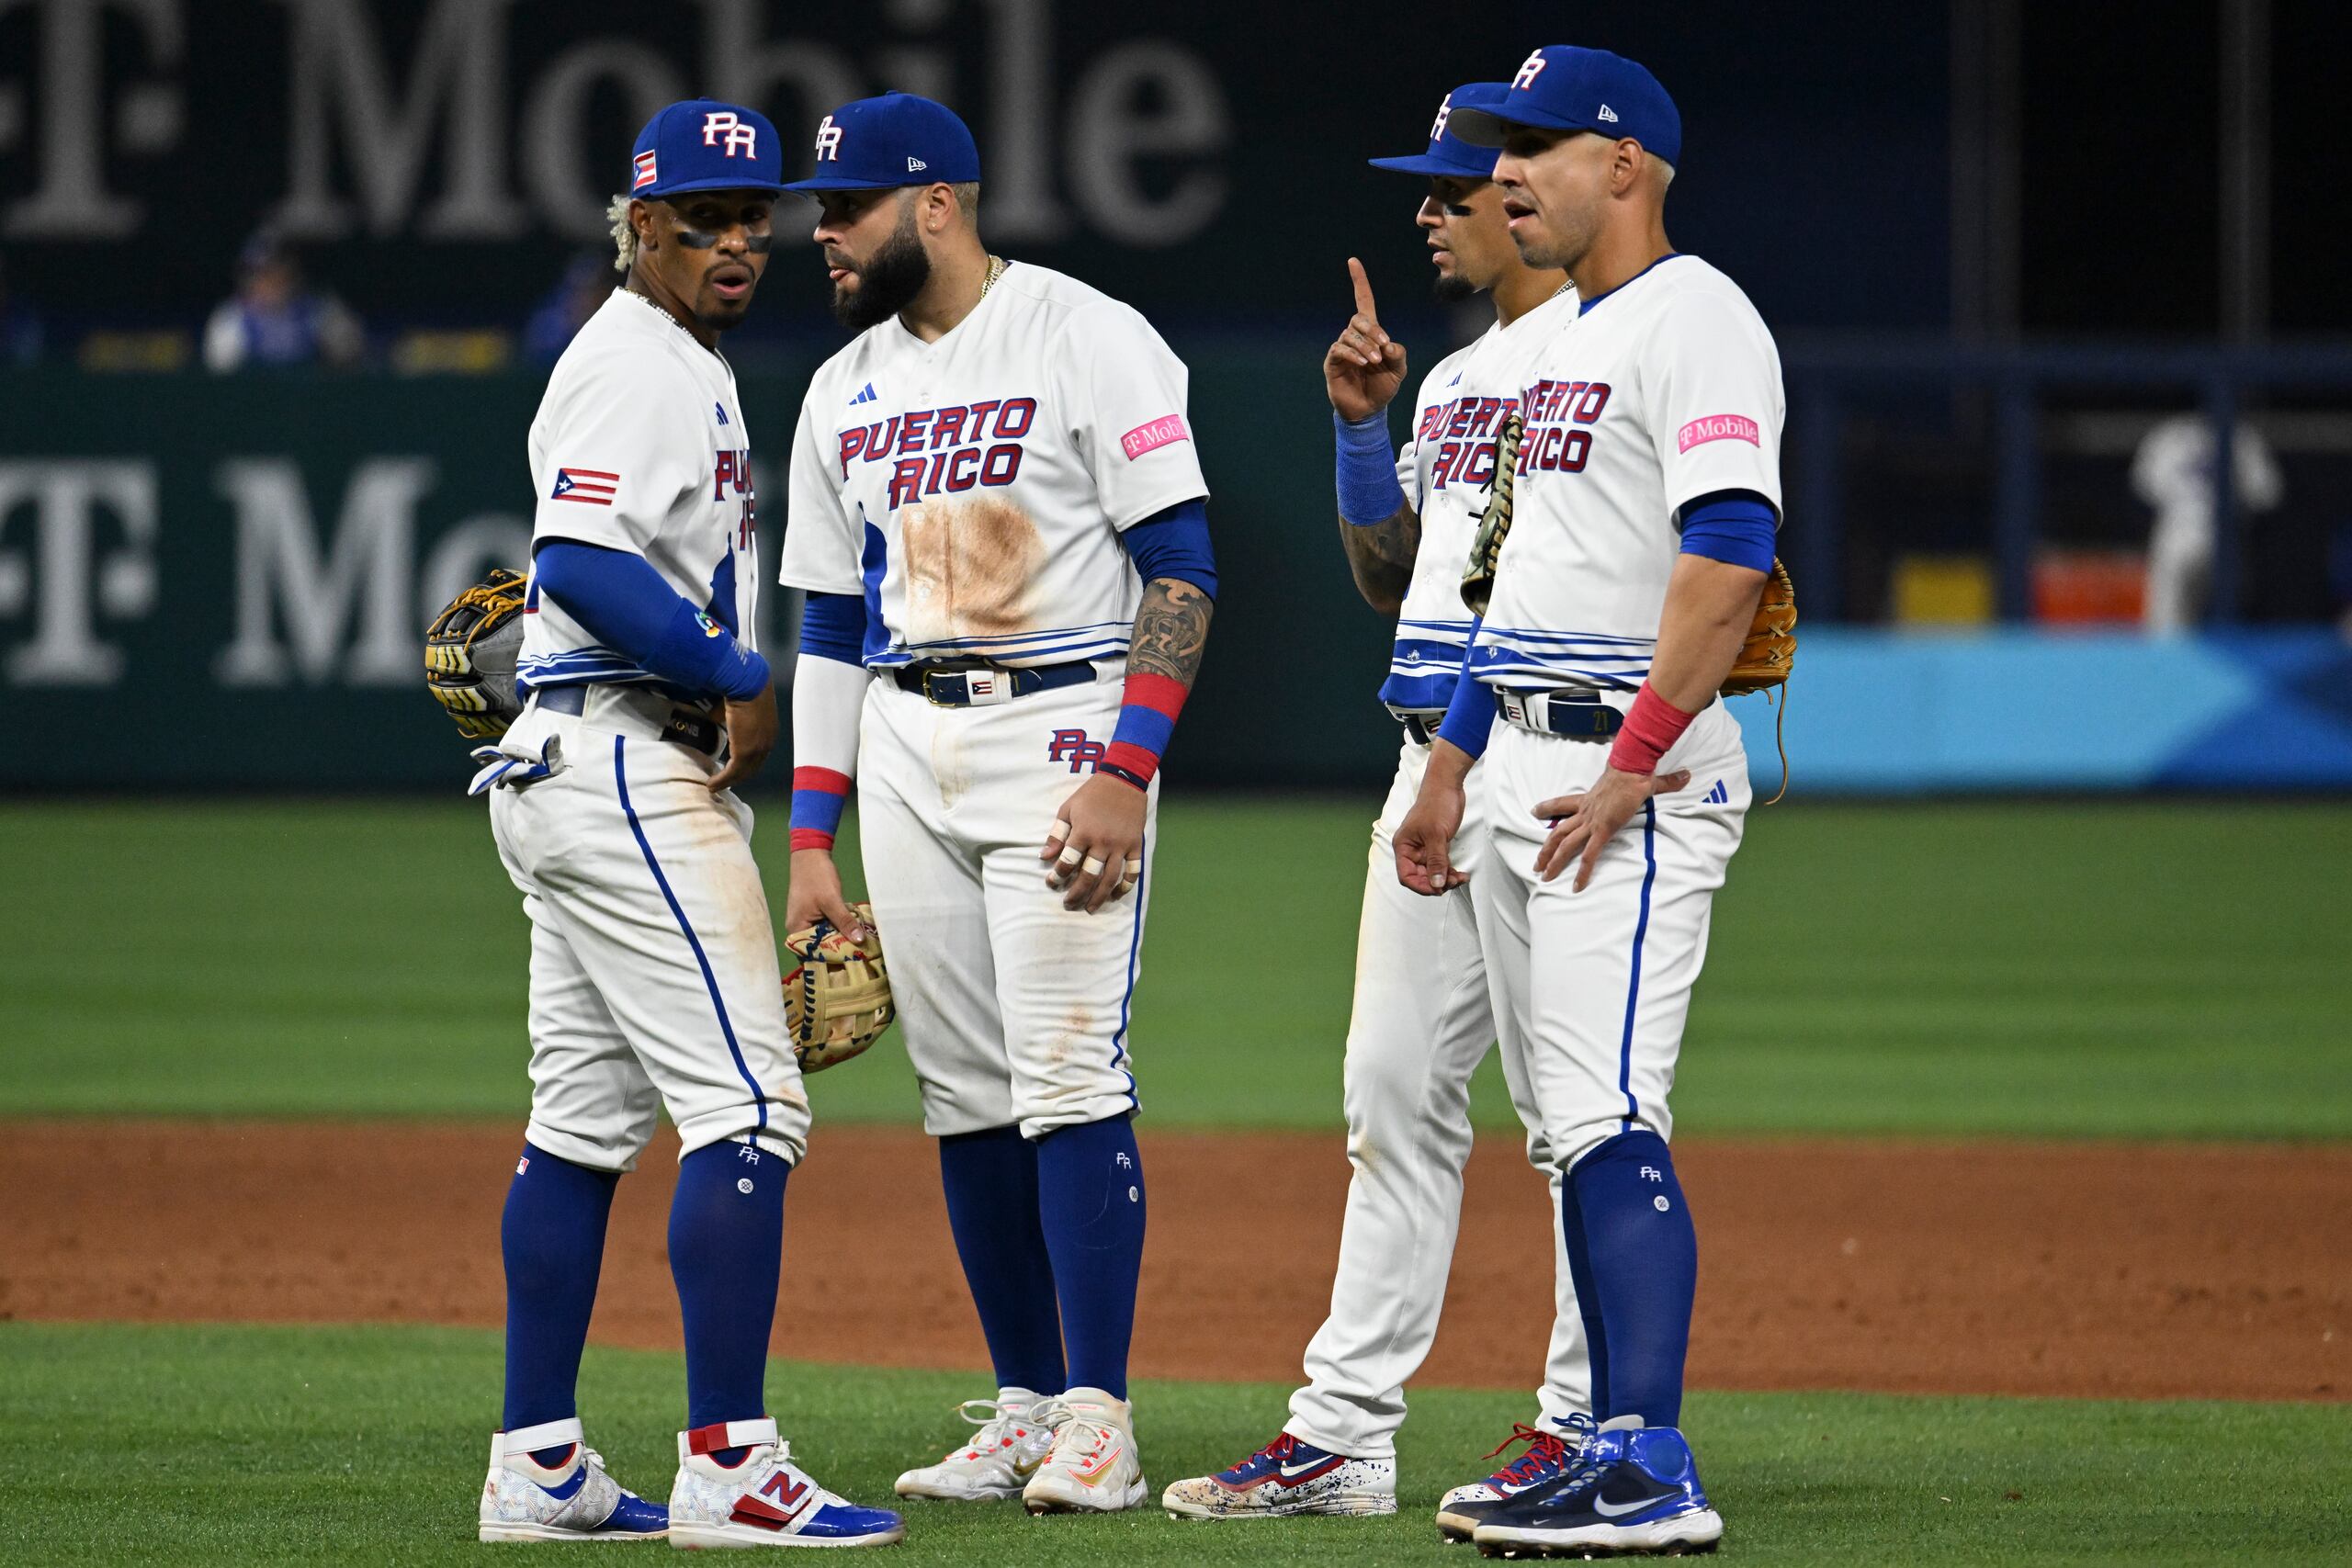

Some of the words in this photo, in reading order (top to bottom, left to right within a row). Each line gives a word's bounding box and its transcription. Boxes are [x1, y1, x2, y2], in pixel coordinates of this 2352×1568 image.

[702, 111, 757, 161] PR
[1521, 378, 1612, 431] UERTO
[838, 397, 1037, 483] PUERTO
[1515, 427, 1594, 478] RICO
[1679, 425, 1693, 447] T
[1695, 417, 1758, 442] Mobile
[887, 443, 1023, 512] RICO
[1048, 728, 1106, 774] PR
[738, 1145, 761, 1166] PR
[1116, 1152, 1132, 1169] PR
[1639, 1166, 1663, 1182] PR
[758, 1470, 809, 1507] N
